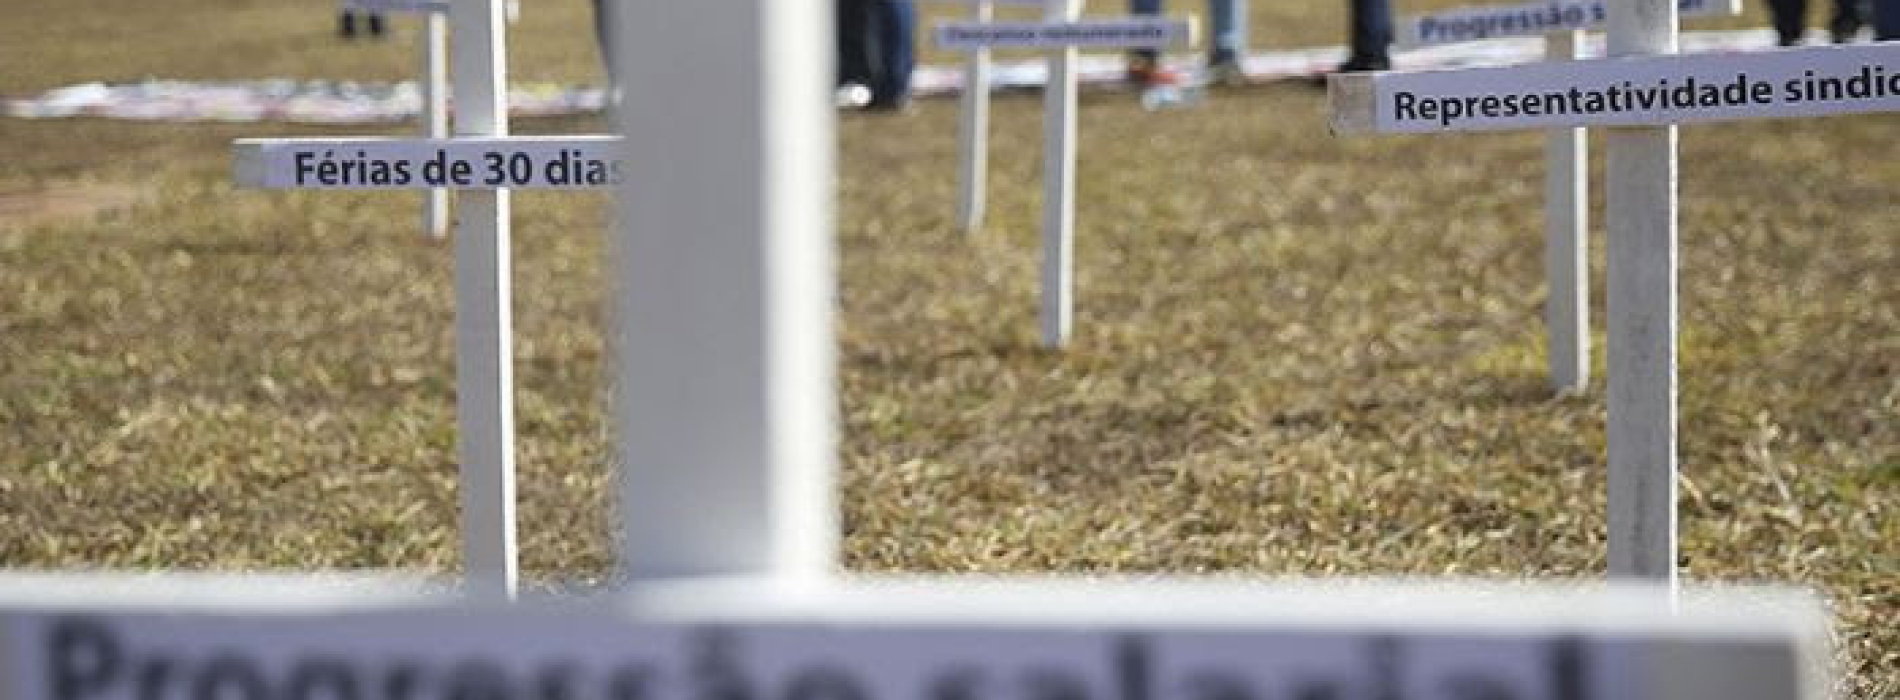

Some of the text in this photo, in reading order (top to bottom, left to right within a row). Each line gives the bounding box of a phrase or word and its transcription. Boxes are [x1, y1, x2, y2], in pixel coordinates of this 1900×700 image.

[1392, 74, 1773, 125] Representatividade
[294, 150, 411, 186] Férias
[422, 150, 471, 186] de
[483, 151, 533, 186] 30
